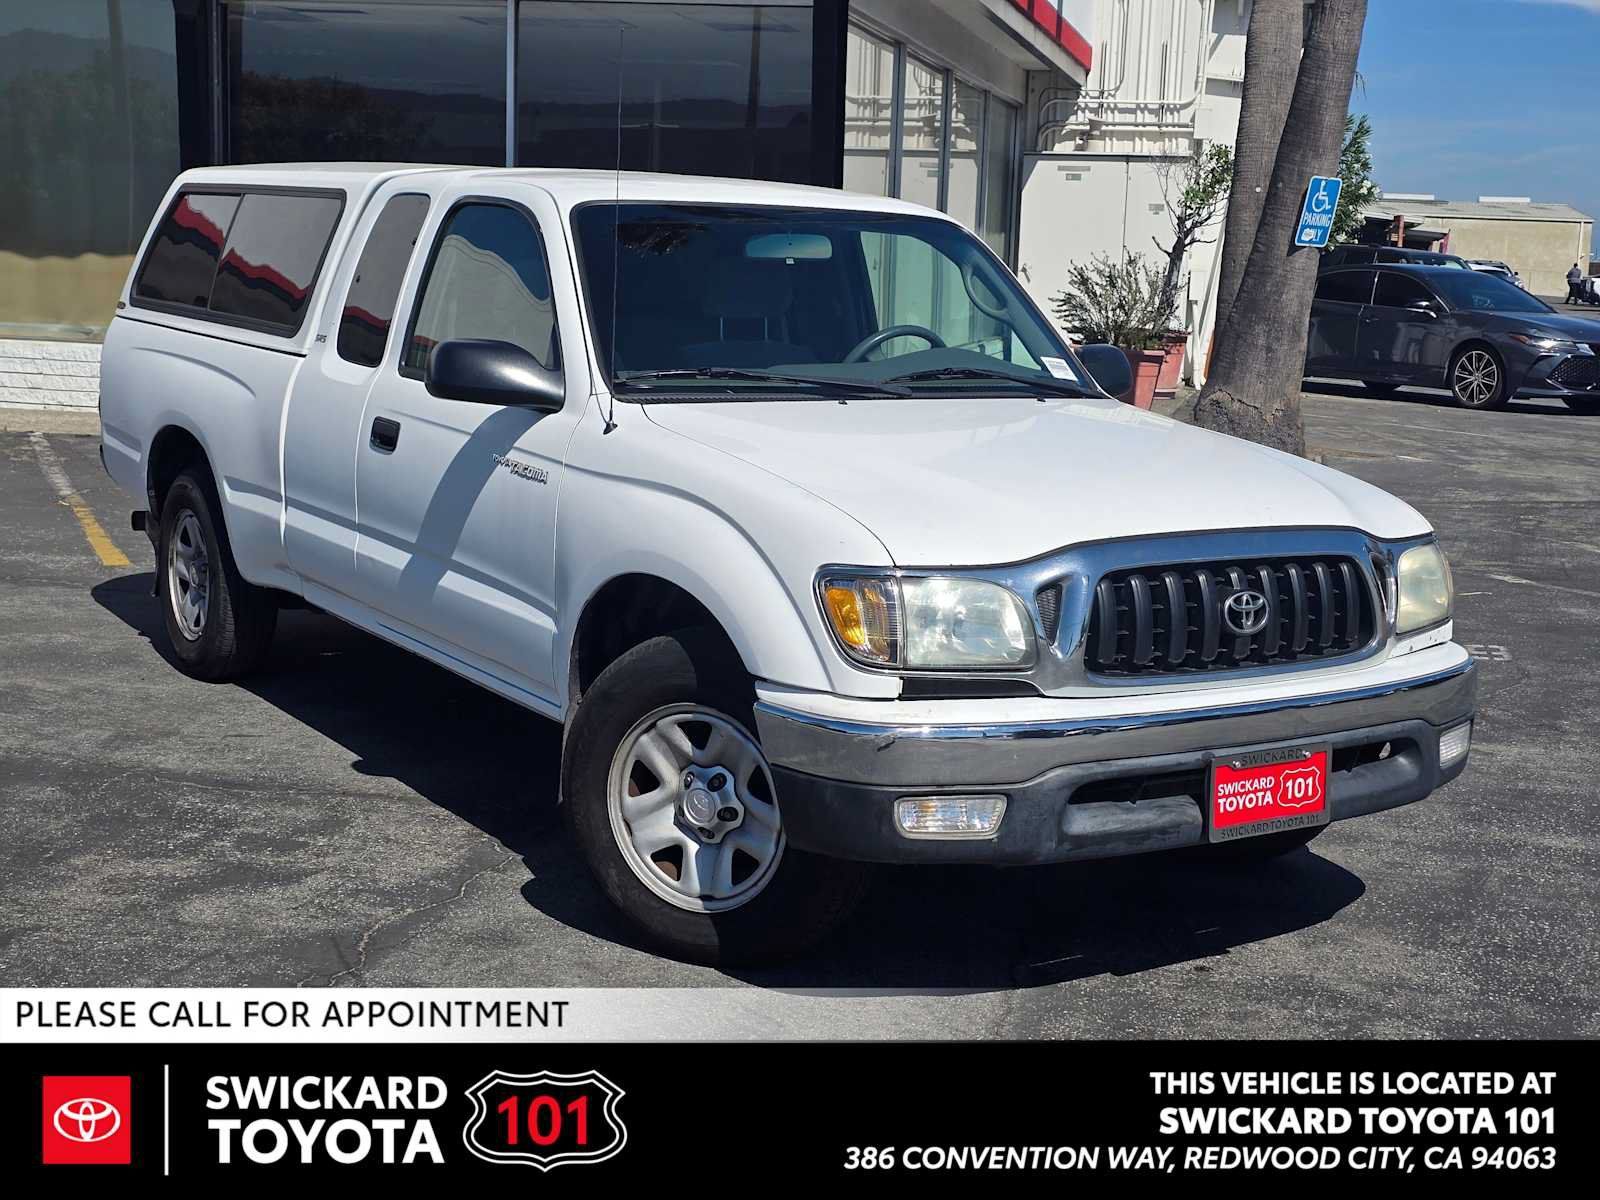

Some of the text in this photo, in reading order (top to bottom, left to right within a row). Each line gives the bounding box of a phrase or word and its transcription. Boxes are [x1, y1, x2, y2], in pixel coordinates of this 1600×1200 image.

[1303, 212, 1332, 226] PARKING
[1301, 228, 1323, 241] LY
[510, 461, 548, 484] TACOMA
[1217, 776, 1275, 796] SWICKARD
[1285, 776, 1313, 799] 101
[1217, 790, 1273, 813] TOYOTA
[1221, 814, 1320, 839] SWICKARD TOYOTA 101
